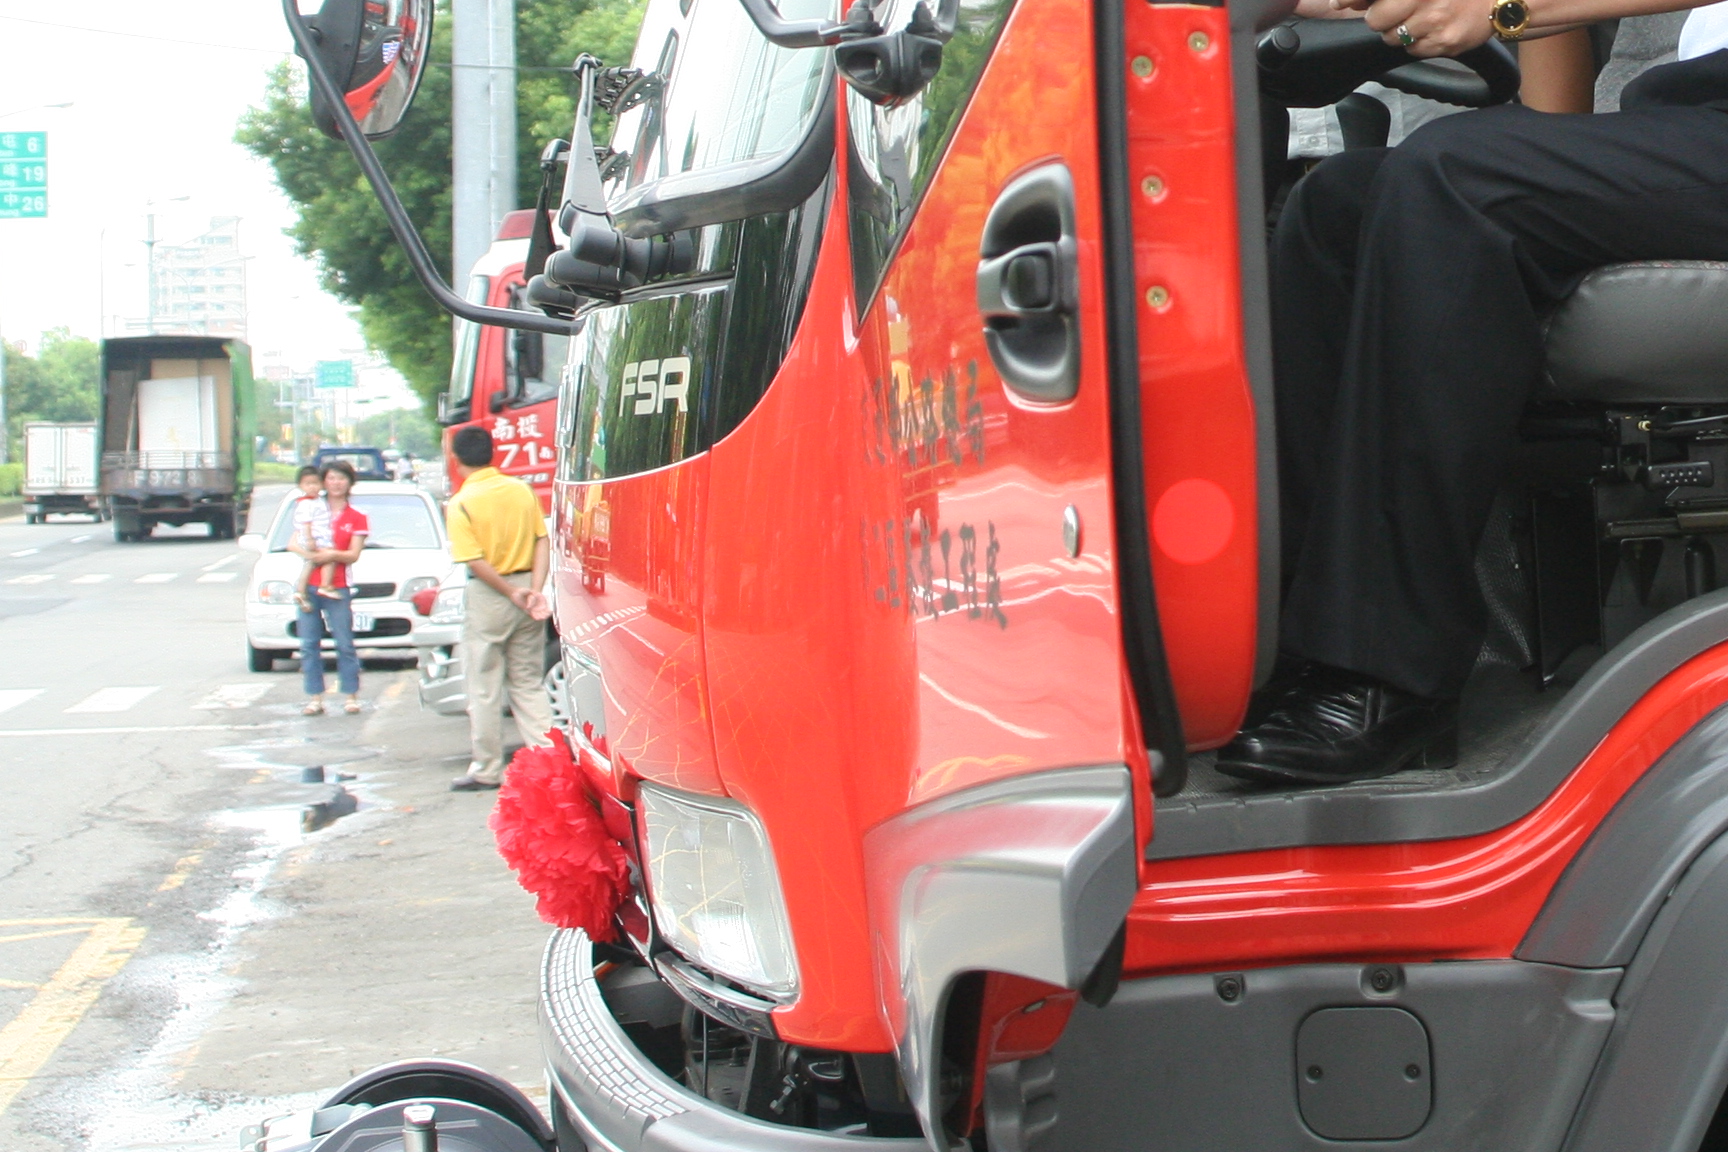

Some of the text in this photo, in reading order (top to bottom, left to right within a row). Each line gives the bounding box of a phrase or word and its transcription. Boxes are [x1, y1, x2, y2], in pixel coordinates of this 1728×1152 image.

[27, 136, 38, 153] 6
[22, 166, 44, 182] 19
[22, 196, 44, 212] 26
[618, 356, 691, 417] FSR
